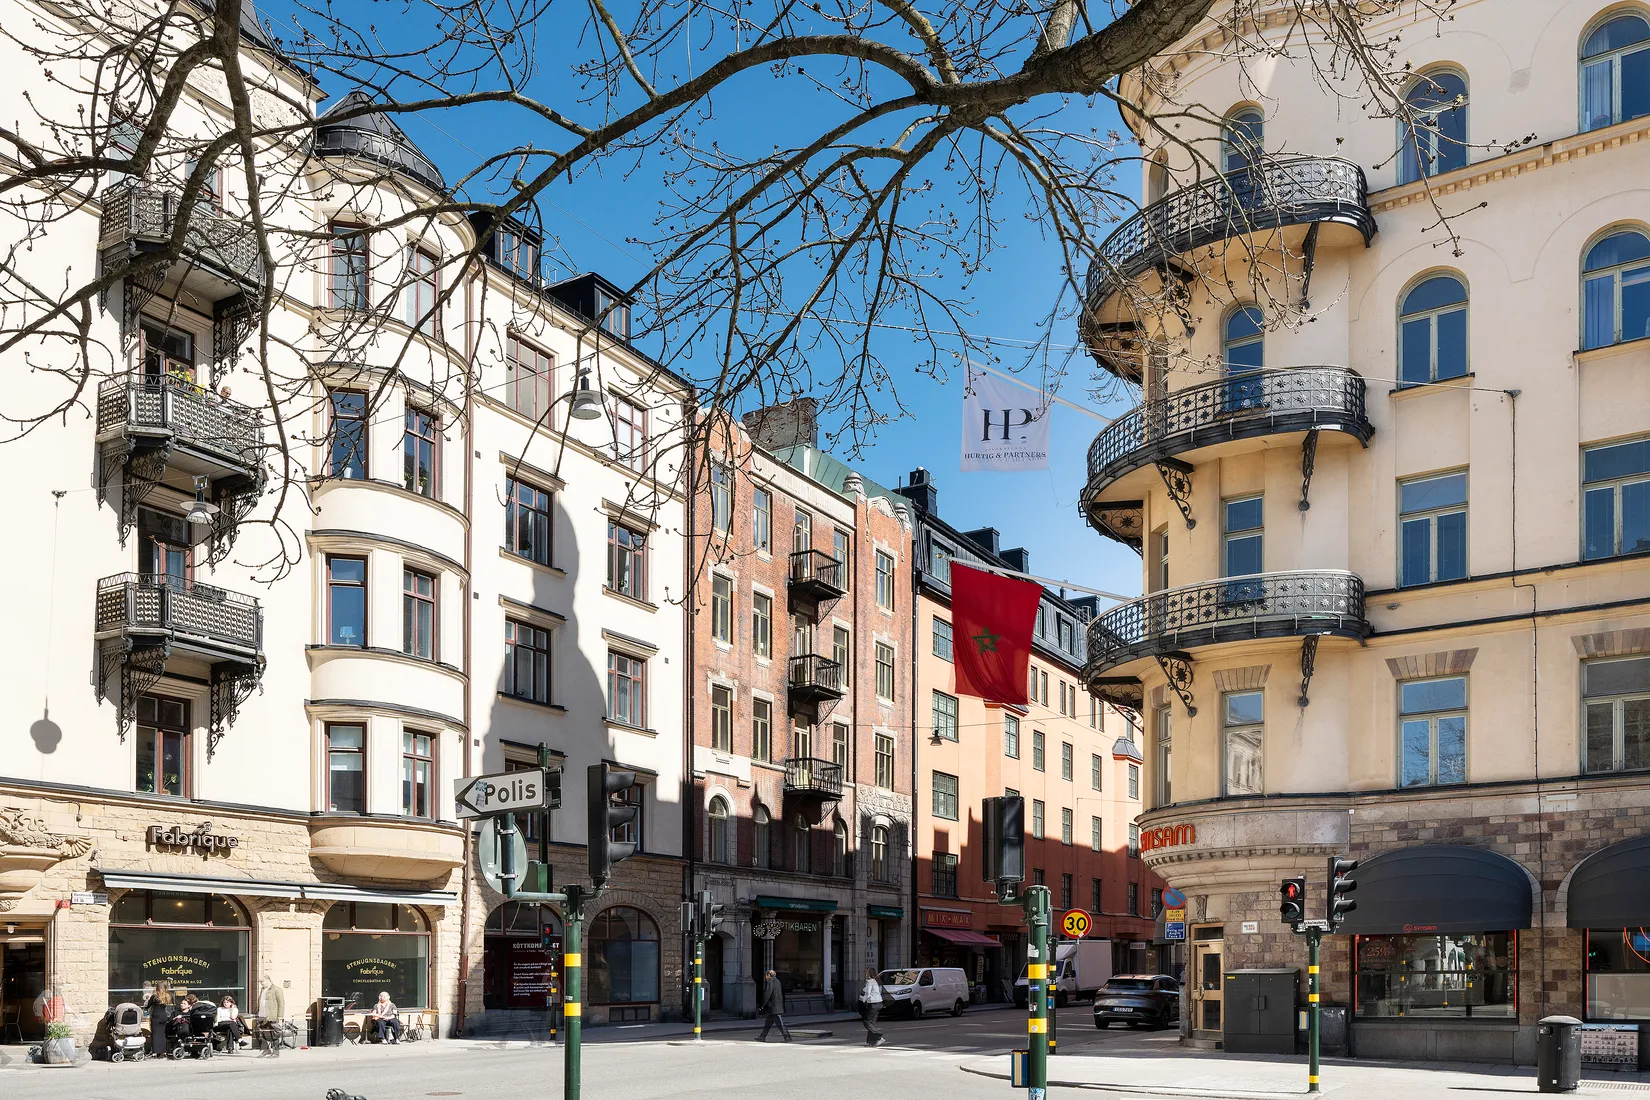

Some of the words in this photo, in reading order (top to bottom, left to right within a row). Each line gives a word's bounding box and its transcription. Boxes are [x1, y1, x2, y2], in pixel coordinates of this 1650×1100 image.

[964, 452, 994, 460] HURTIG
[1004, 451, 1046, 459] PARTNERS
[485, 779, 537, 806] Polis
[147, 822, 239, 853] Fabrique
[1066, 916, 1087, 931] 30
[142, 955, 211, 969] STENUGNSBAGERI
[161, 965, 193, 977] Fabrique
[359, 965, 385, 977] Fabrique
